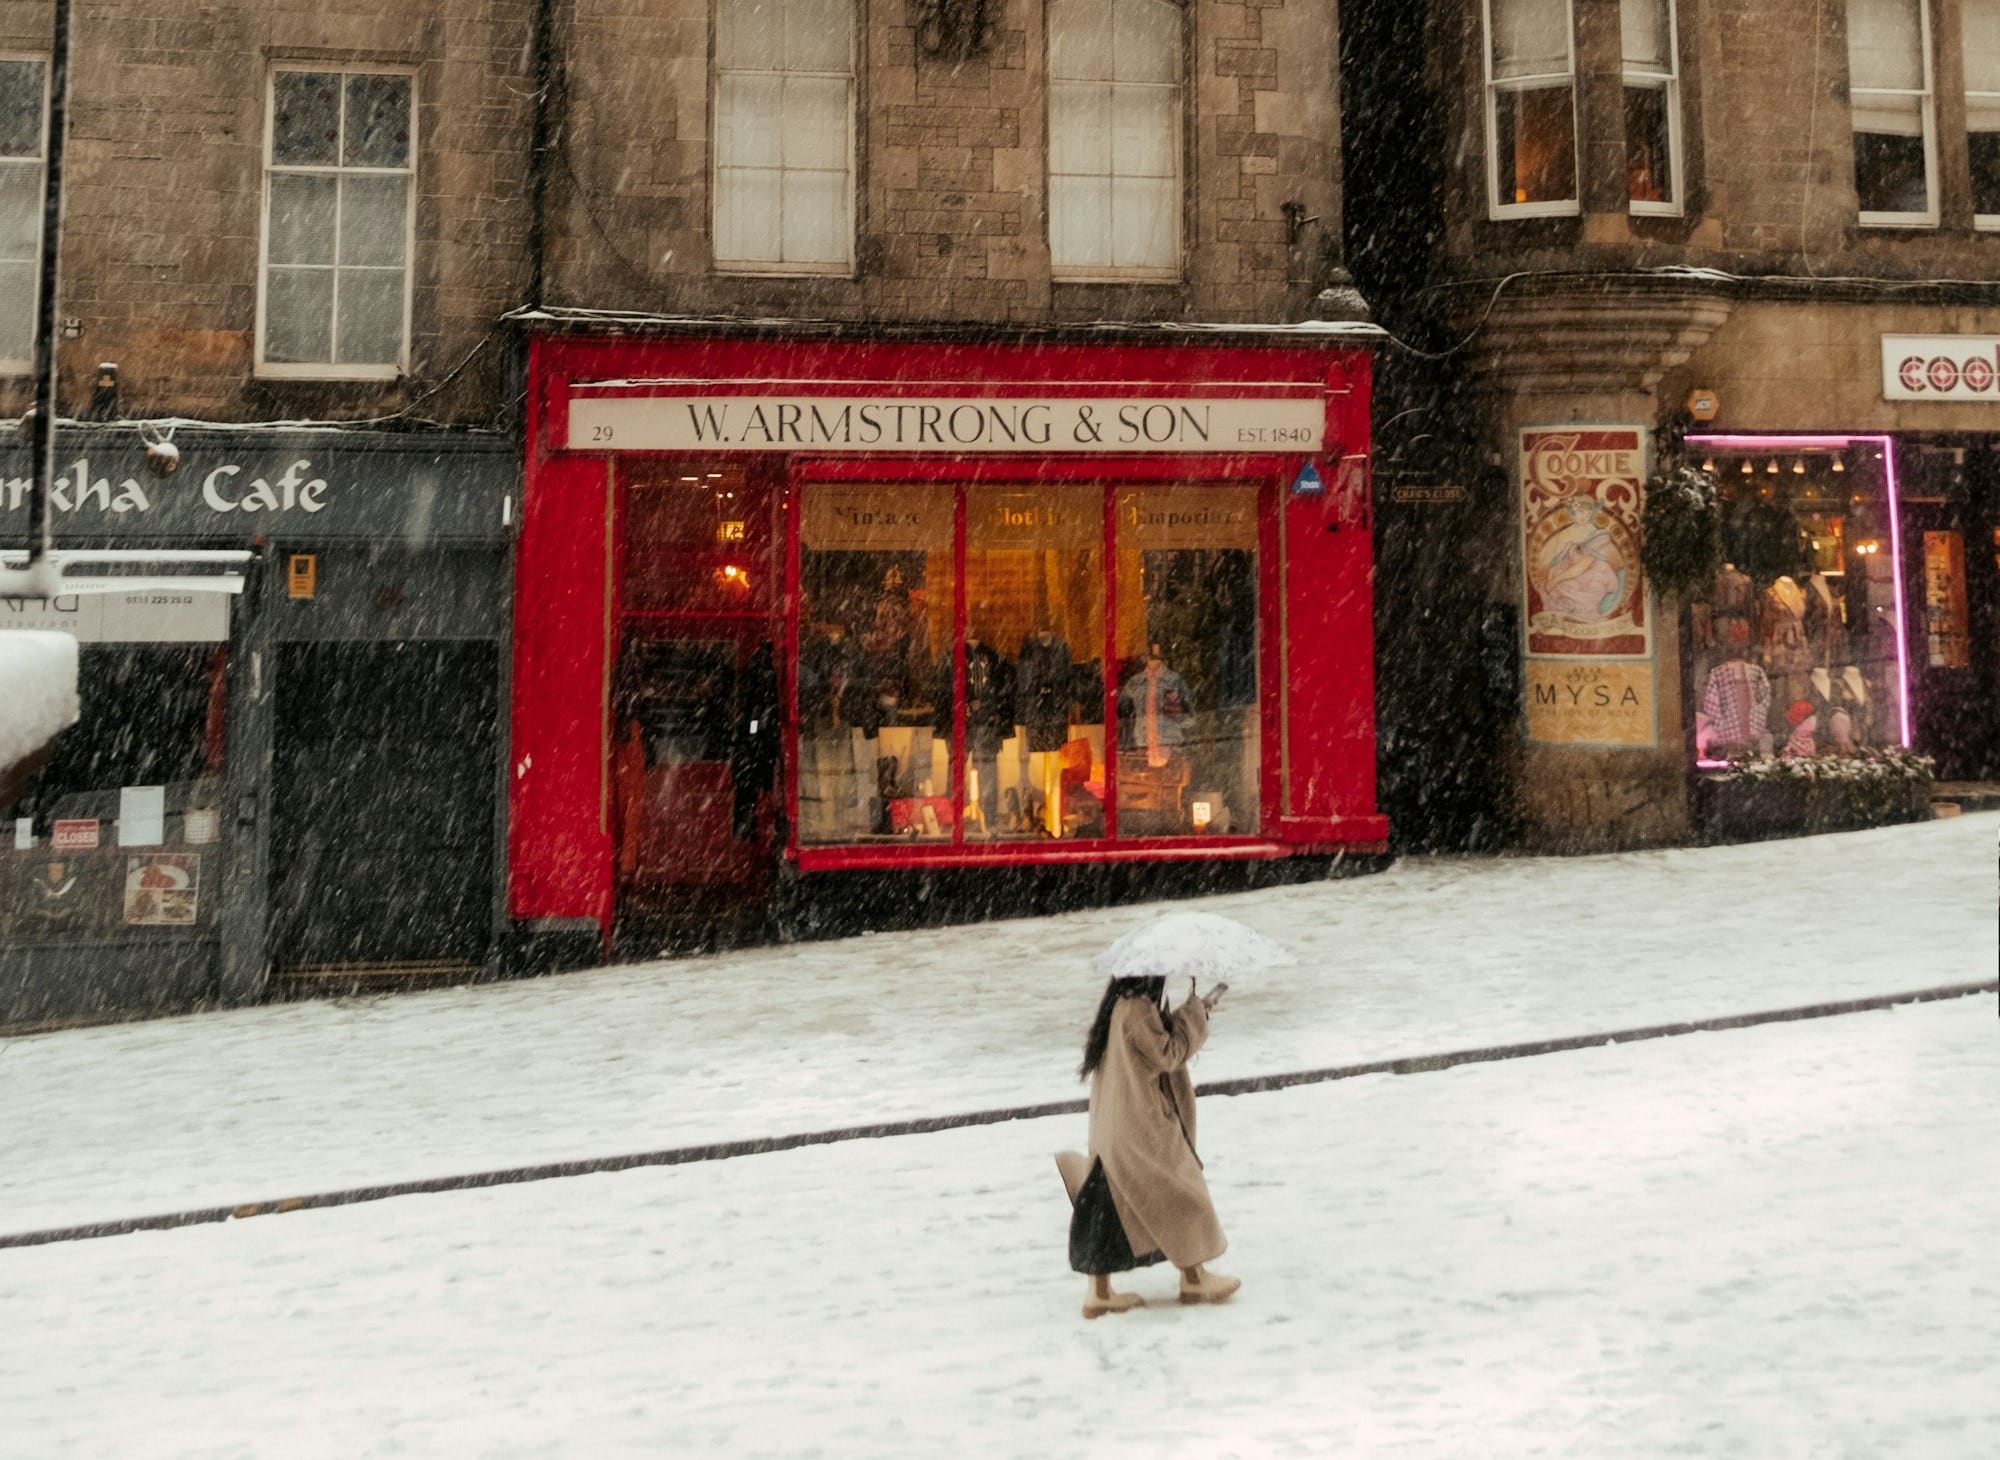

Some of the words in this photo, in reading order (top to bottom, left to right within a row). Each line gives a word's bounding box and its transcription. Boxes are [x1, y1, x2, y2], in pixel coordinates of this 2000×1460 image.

[591, 426, 613, 441] 29
[687, 404, 729, 442] W.
[740, 404, 1051, 443] ARMSTRONG
[1073, 405, 1103, 442] &
[1118, 405, 1210, 442] SON
[1237, 428, 1267, 442] EST.
[1272, 427, 1311, 442] 1840
[1528, 434, 1631, 498] COOKIE
[0, 458, 150, 512] rkha
[202, 459, 328, 513] Cafe
[1535, 683, 1639, 706] MYSA
